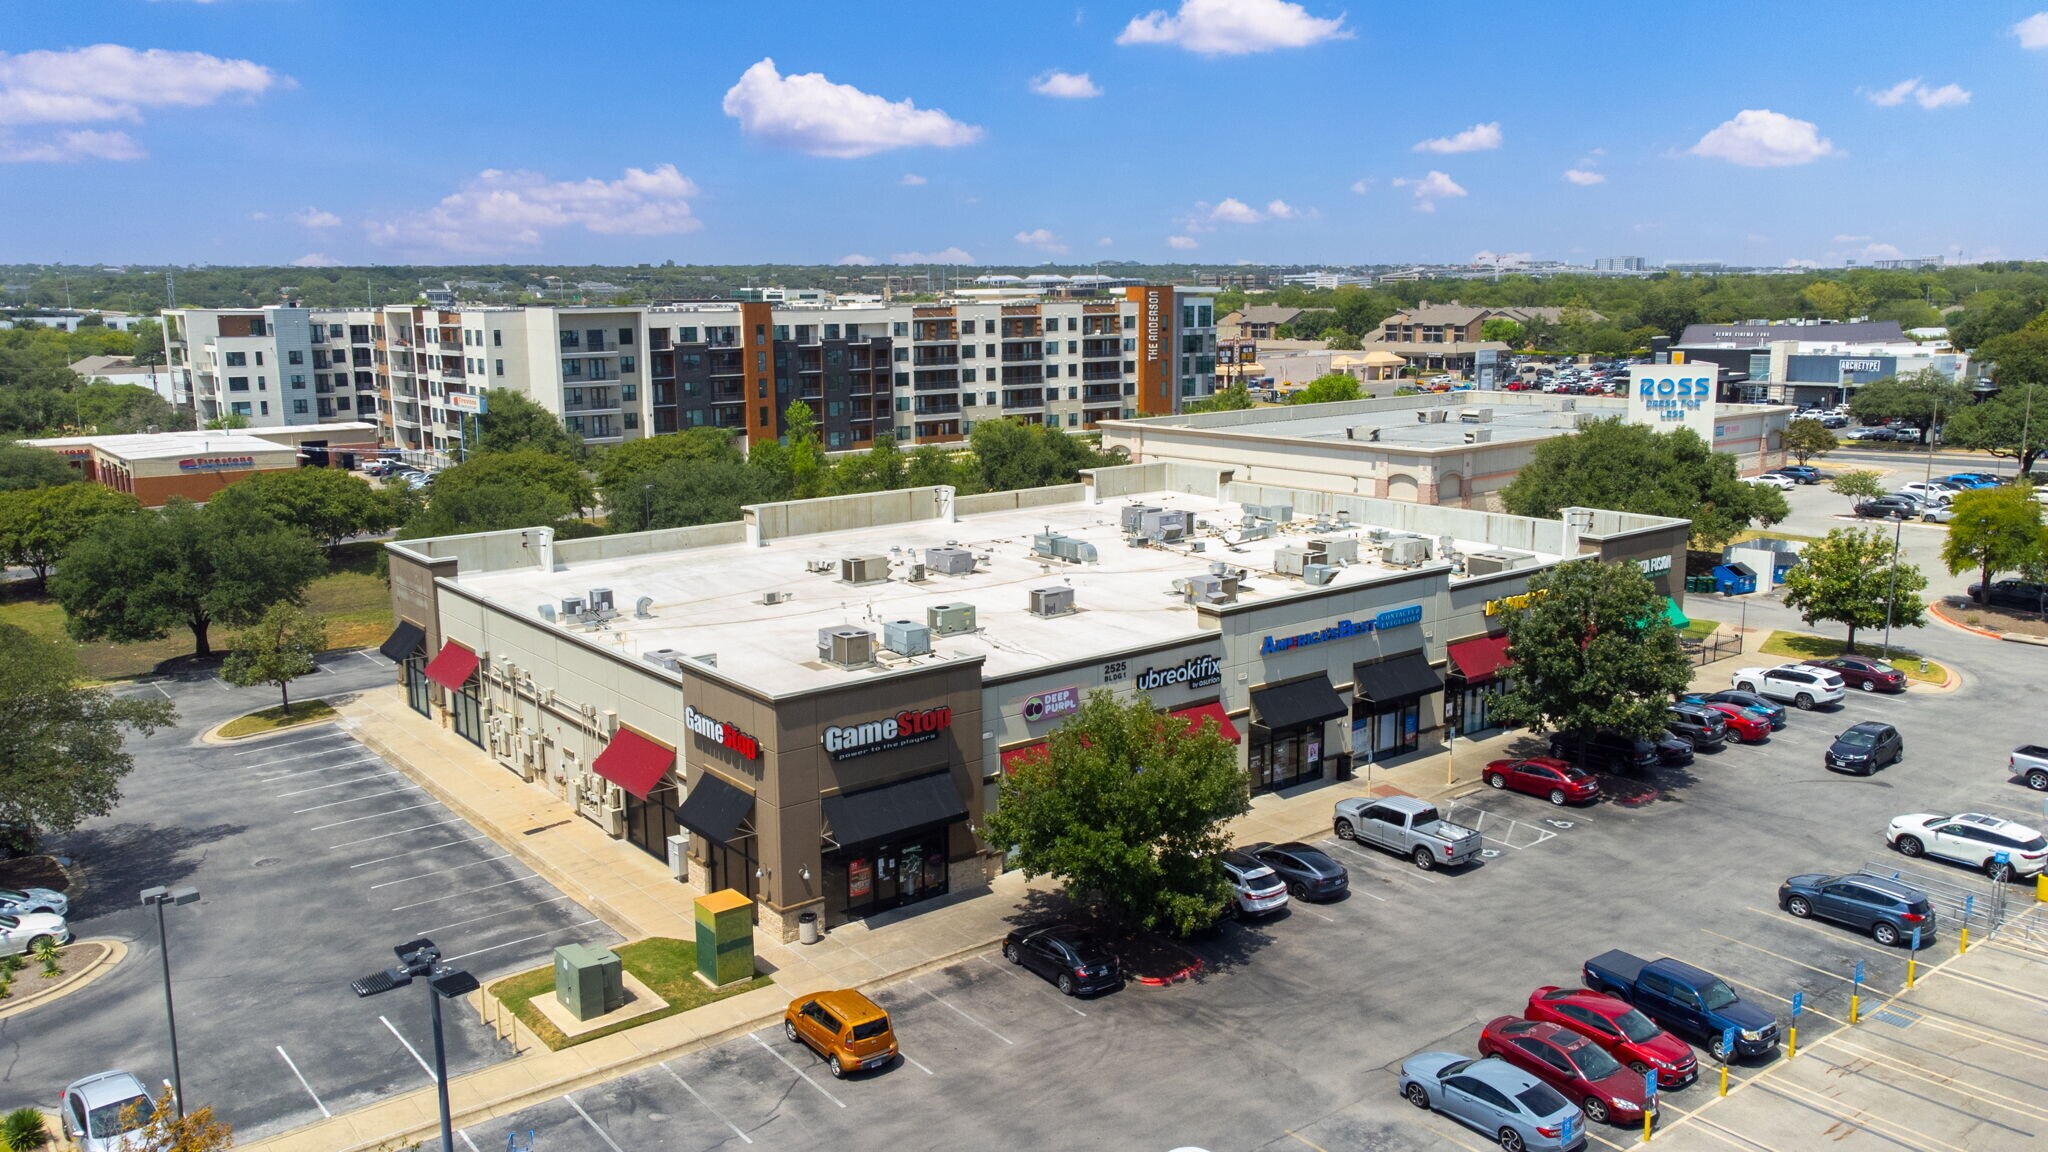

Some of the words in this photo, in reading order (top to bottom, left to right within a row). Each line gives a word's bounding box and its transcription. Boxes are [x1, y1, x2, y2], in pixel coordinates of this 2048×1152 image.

[1148, 291, 1159, 341] ANDERSON
[1148, 343, 1158, 361] THE
[1841, 361, 1878, 370] ARCHETYPE
[1640, 378, 1710, 396] ROSS
[1646, 400, 1677, 409] DRESS
[1681, 399, 1701, 409] FOR
[1660, 410, 1685, 419] LESS
[1104, 661, 1127, 675] 2525
[1139, 657, 1220, 690] ubreakifix
[1104, 674, 1122, 682] BLDG
[1199, 677, 1220, 687] asurion
[1044, 690, 1070, 705] DEEP
[1044, 700, 1076, 714] PURPL
[685, 705, 758, 760] GameStop
[823, 706, 952, 752] GameStop
[839, 748, 868, 760] power
[883, 741, 898, 750] the
[900, 733, 936, 746] players
